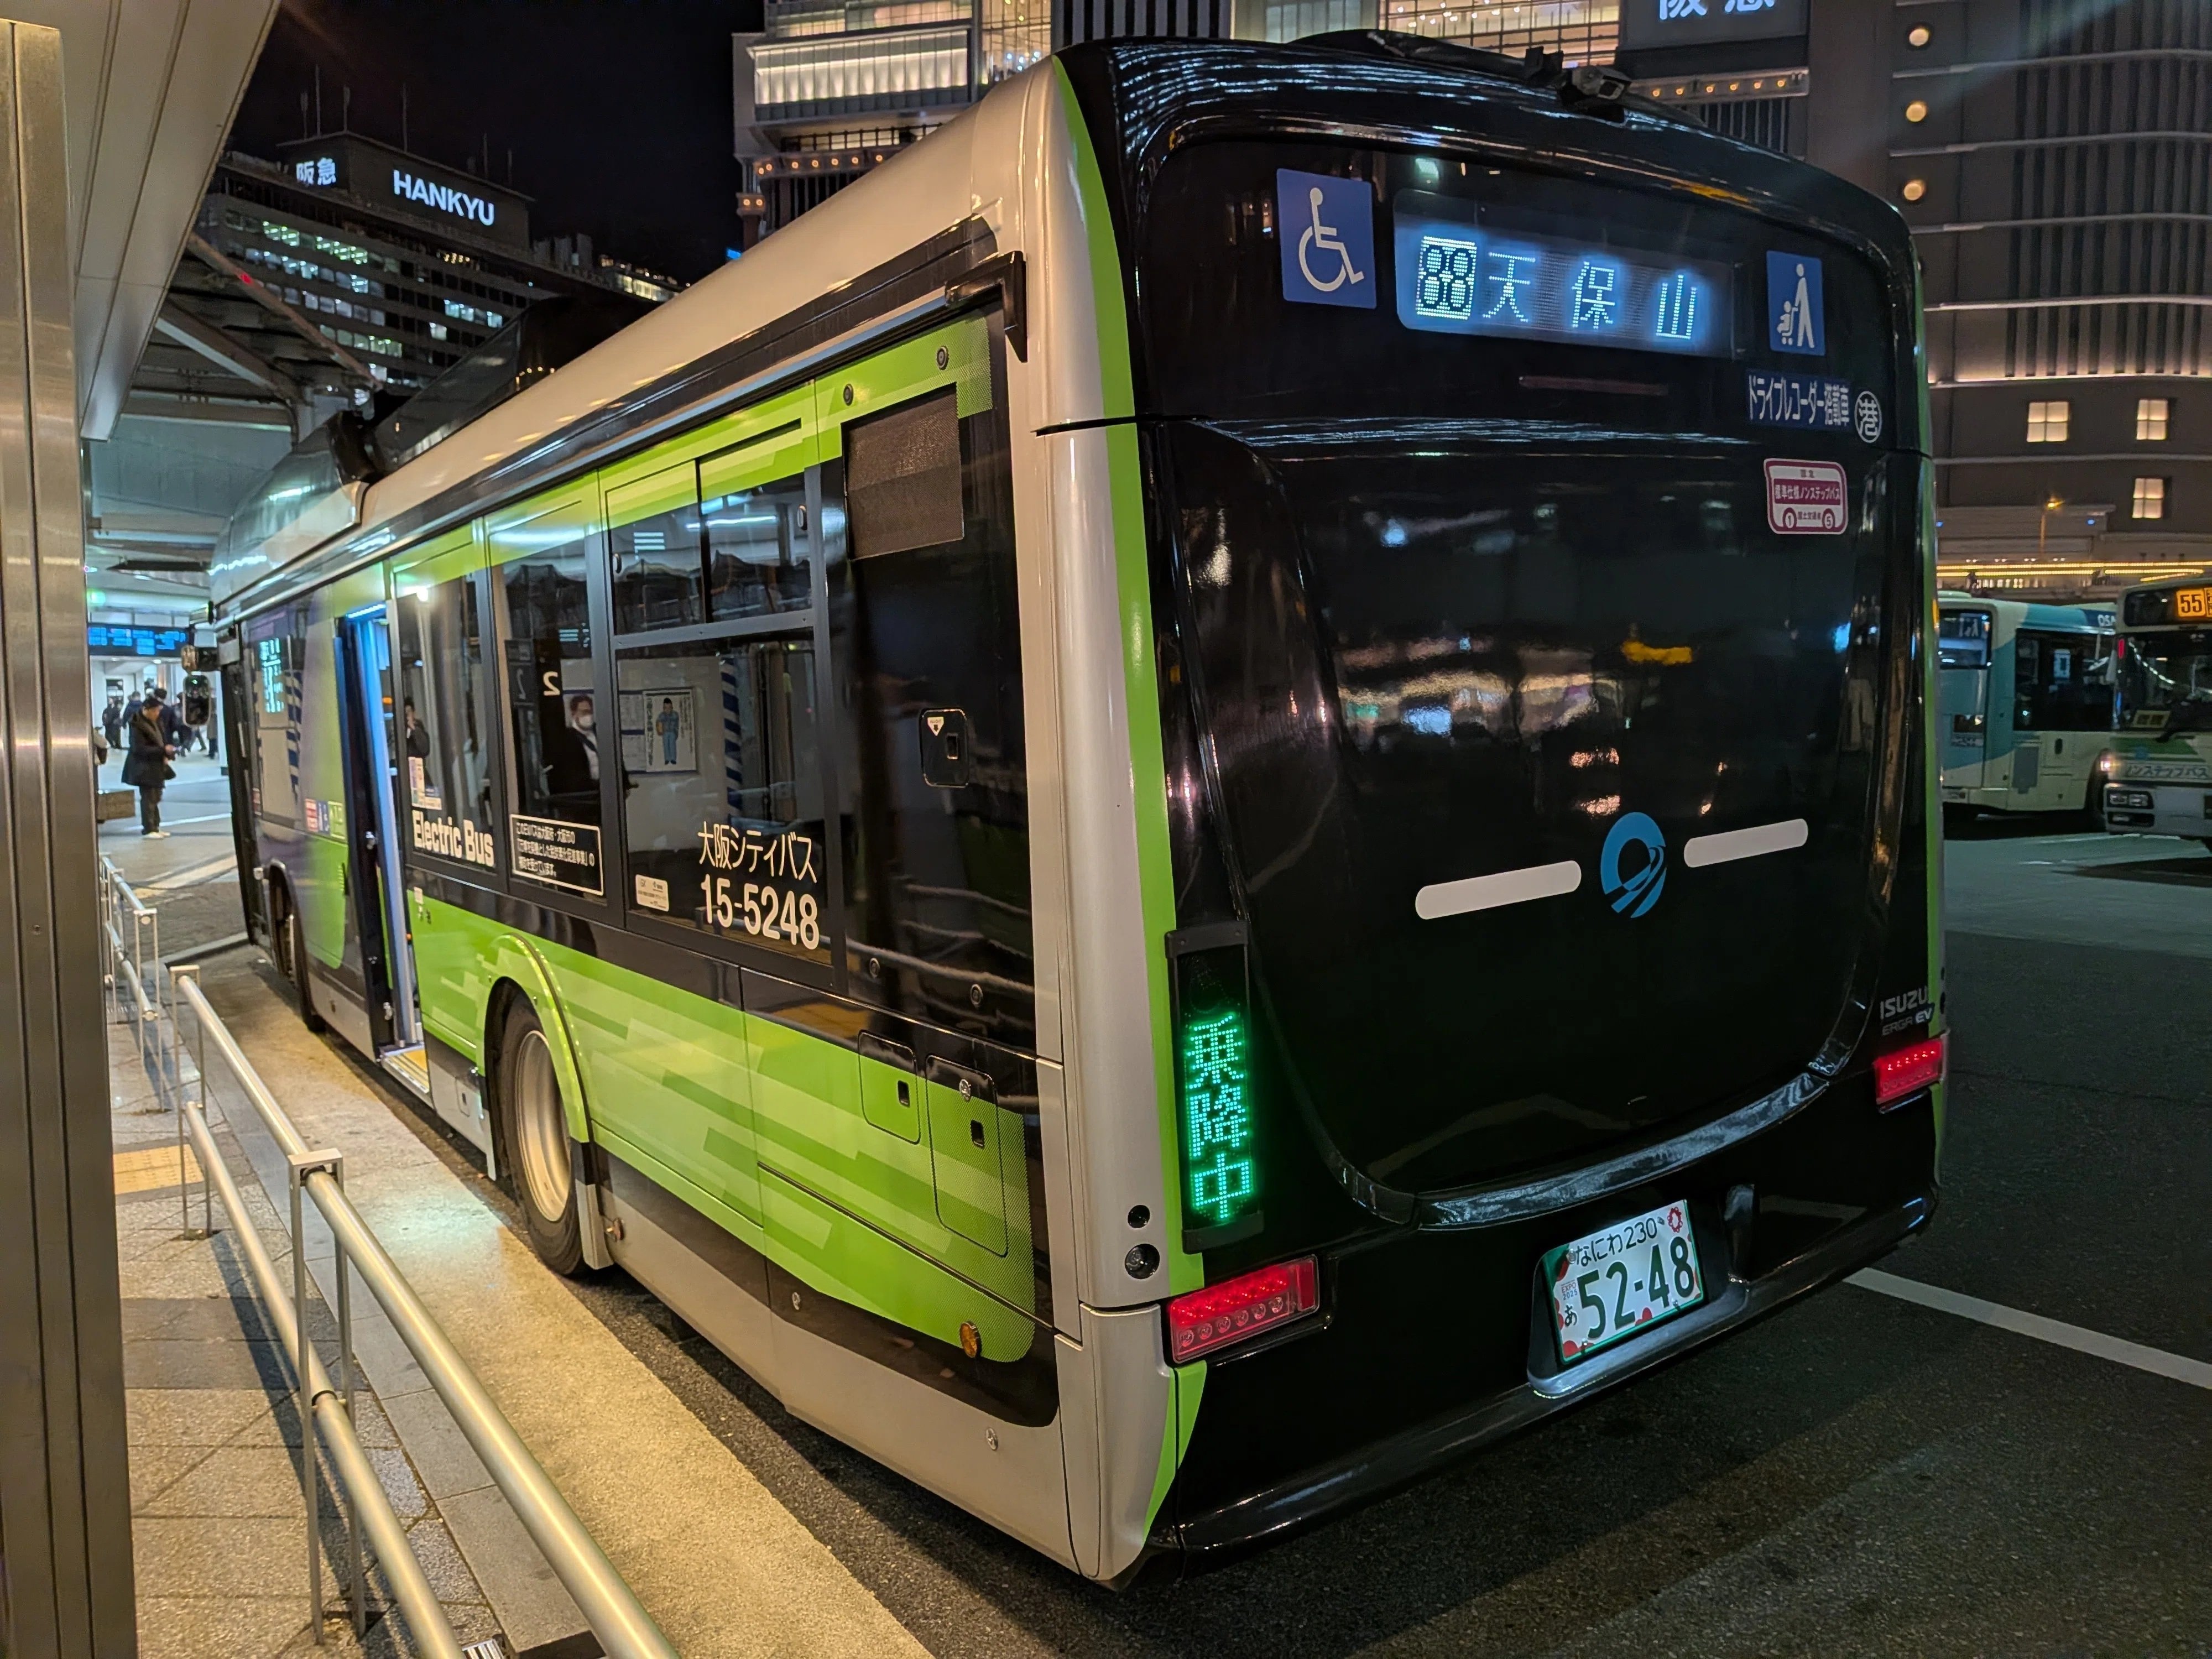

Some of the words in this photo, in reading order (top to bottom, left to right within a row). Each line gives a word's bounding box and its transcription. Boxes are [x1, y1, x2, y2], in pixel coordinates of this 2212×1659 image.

[296, 157, 336, 186] 阪急
[393, 170, 494, 226] HANKYU
[1417, 239, 1476, 317] 88
[1483, 252, 1697, 339] 天保山
[2180, 593, 2203, 613] 55
[412, 810, 462, 859] Electric
[463, 820, 494, 867] Bus
[698, 821, 817, 884] 大阪シティバス
[701, 873, 819, 950] 15-5248
[1880, 985, 1927, 1020] ISUZU
[1915, 1008, 1933, 1024] EV
[1187, 1014, 1251, 1219] 乗降中
[1561, 1282, 1576, 1293] EXPO
[1564, 1305, 1577, 1327] あ
[1577, 1236, 1694, 1339] 52-48
